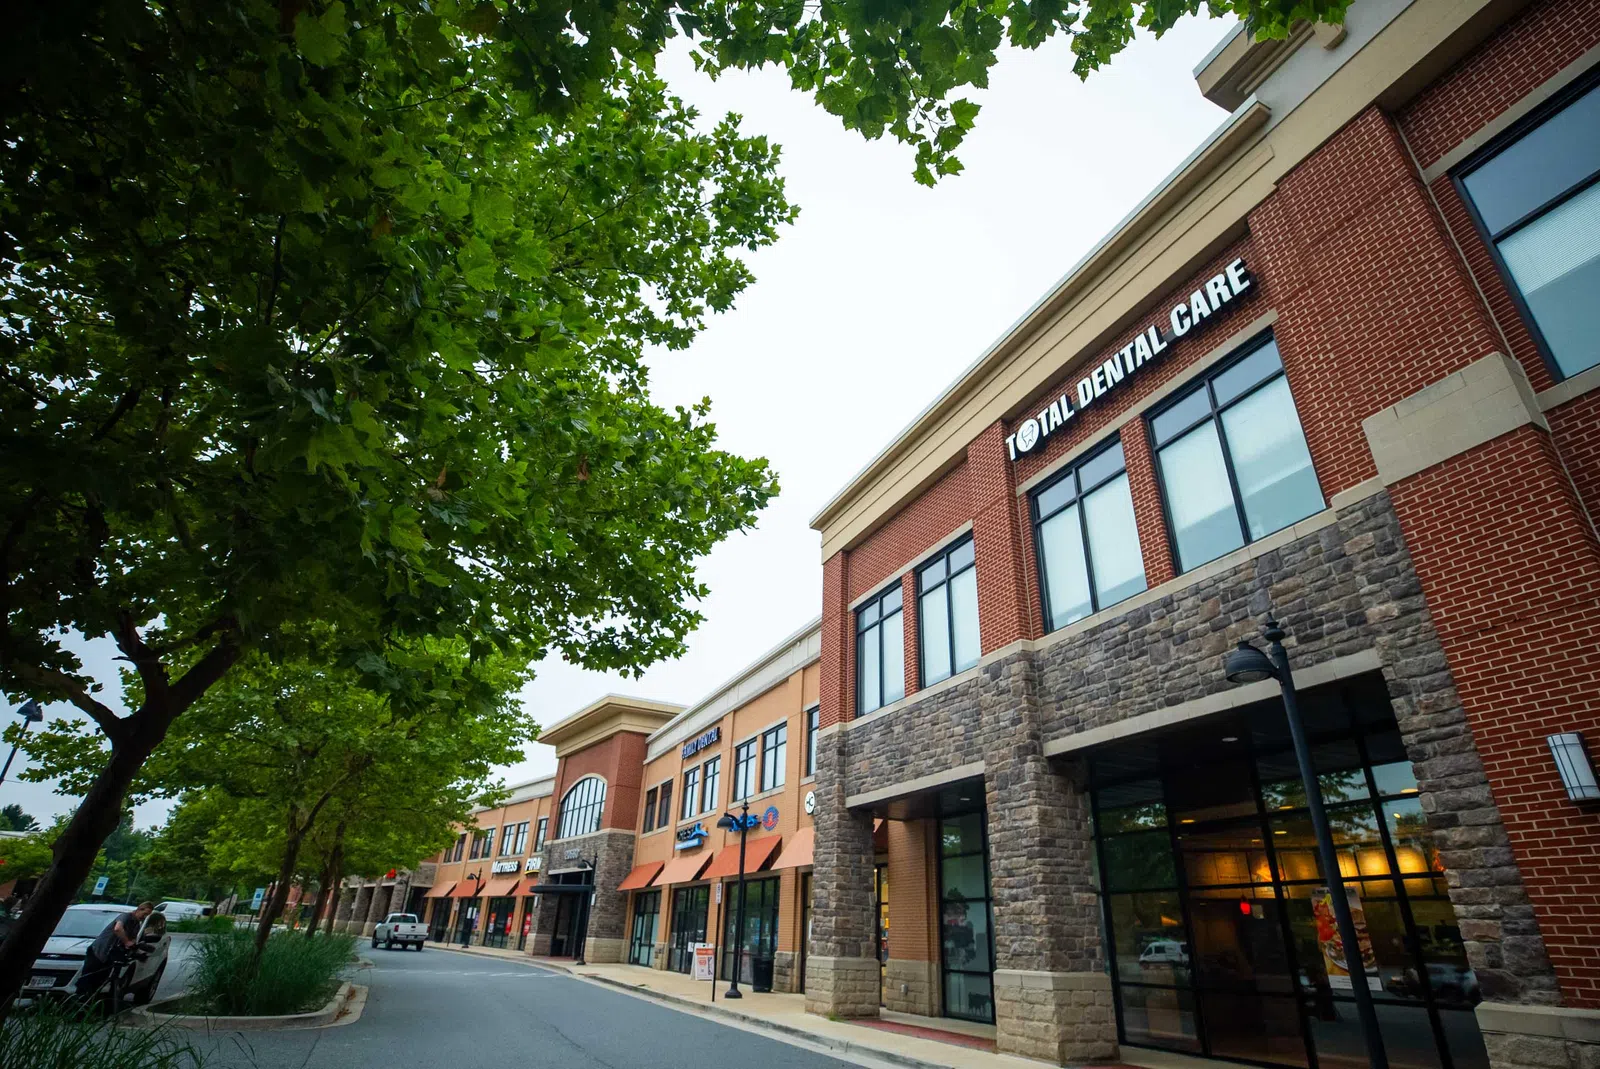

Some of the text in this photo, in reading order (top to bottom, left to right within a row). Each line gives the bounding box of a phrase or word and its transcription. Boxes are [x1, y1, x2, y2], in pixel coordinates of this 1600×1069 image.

[1005, 258, 1250, 461] TOTAL DENTAL CARE
[682, 727, 718, 759] FAMILY DENTAL
